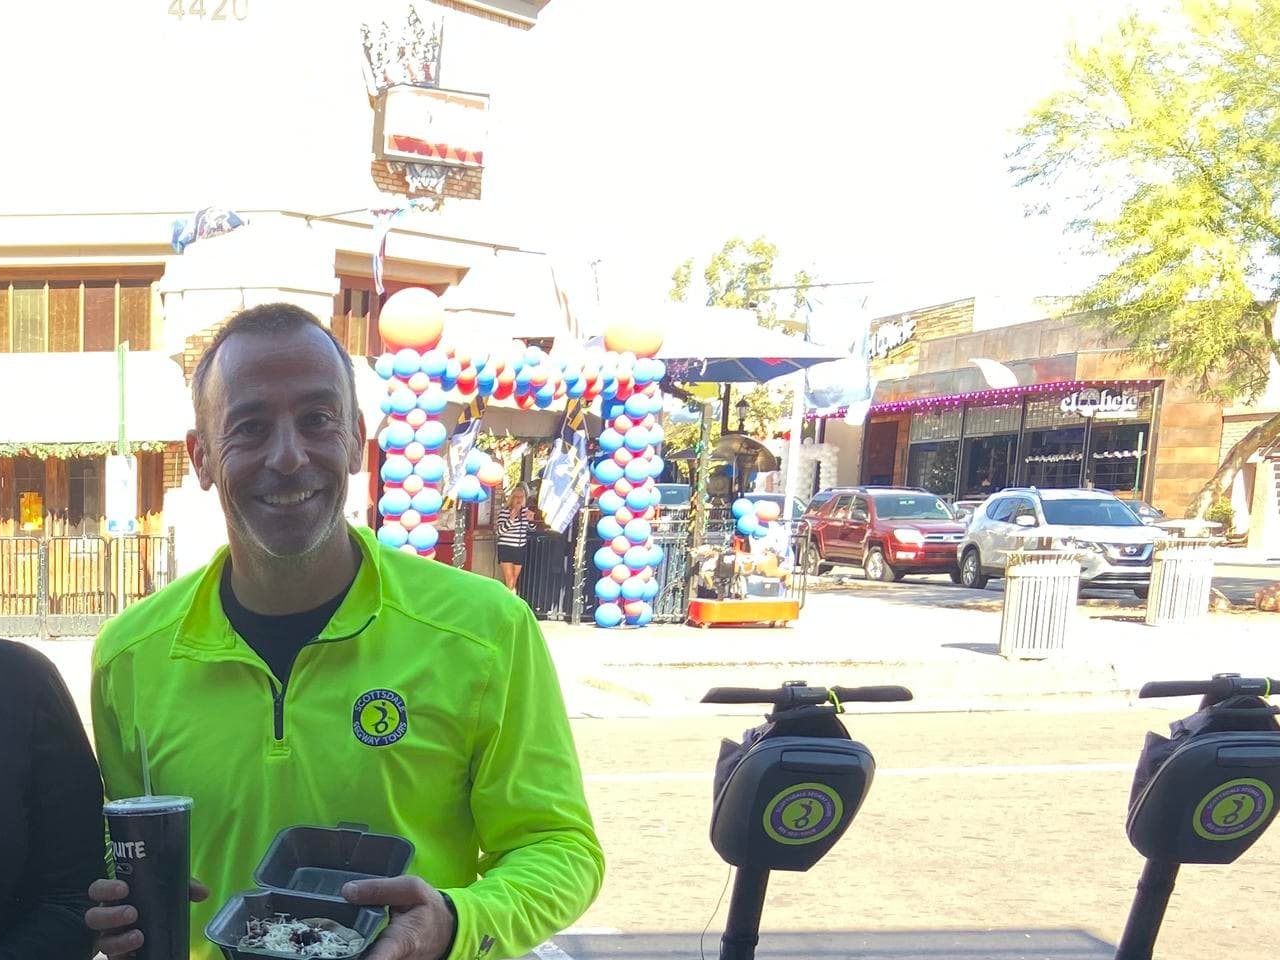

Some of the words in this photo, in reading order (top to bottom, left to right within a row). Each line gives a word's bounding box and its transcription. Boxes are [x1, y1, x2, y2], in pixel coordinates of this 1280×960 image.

[167, 0, 249, 22] 4420
[354, 690, 406, 712] SCOTTSDALE
[353, 721, 382, 745] SEGWAY
[381, 721, 407, 745] TOURS
